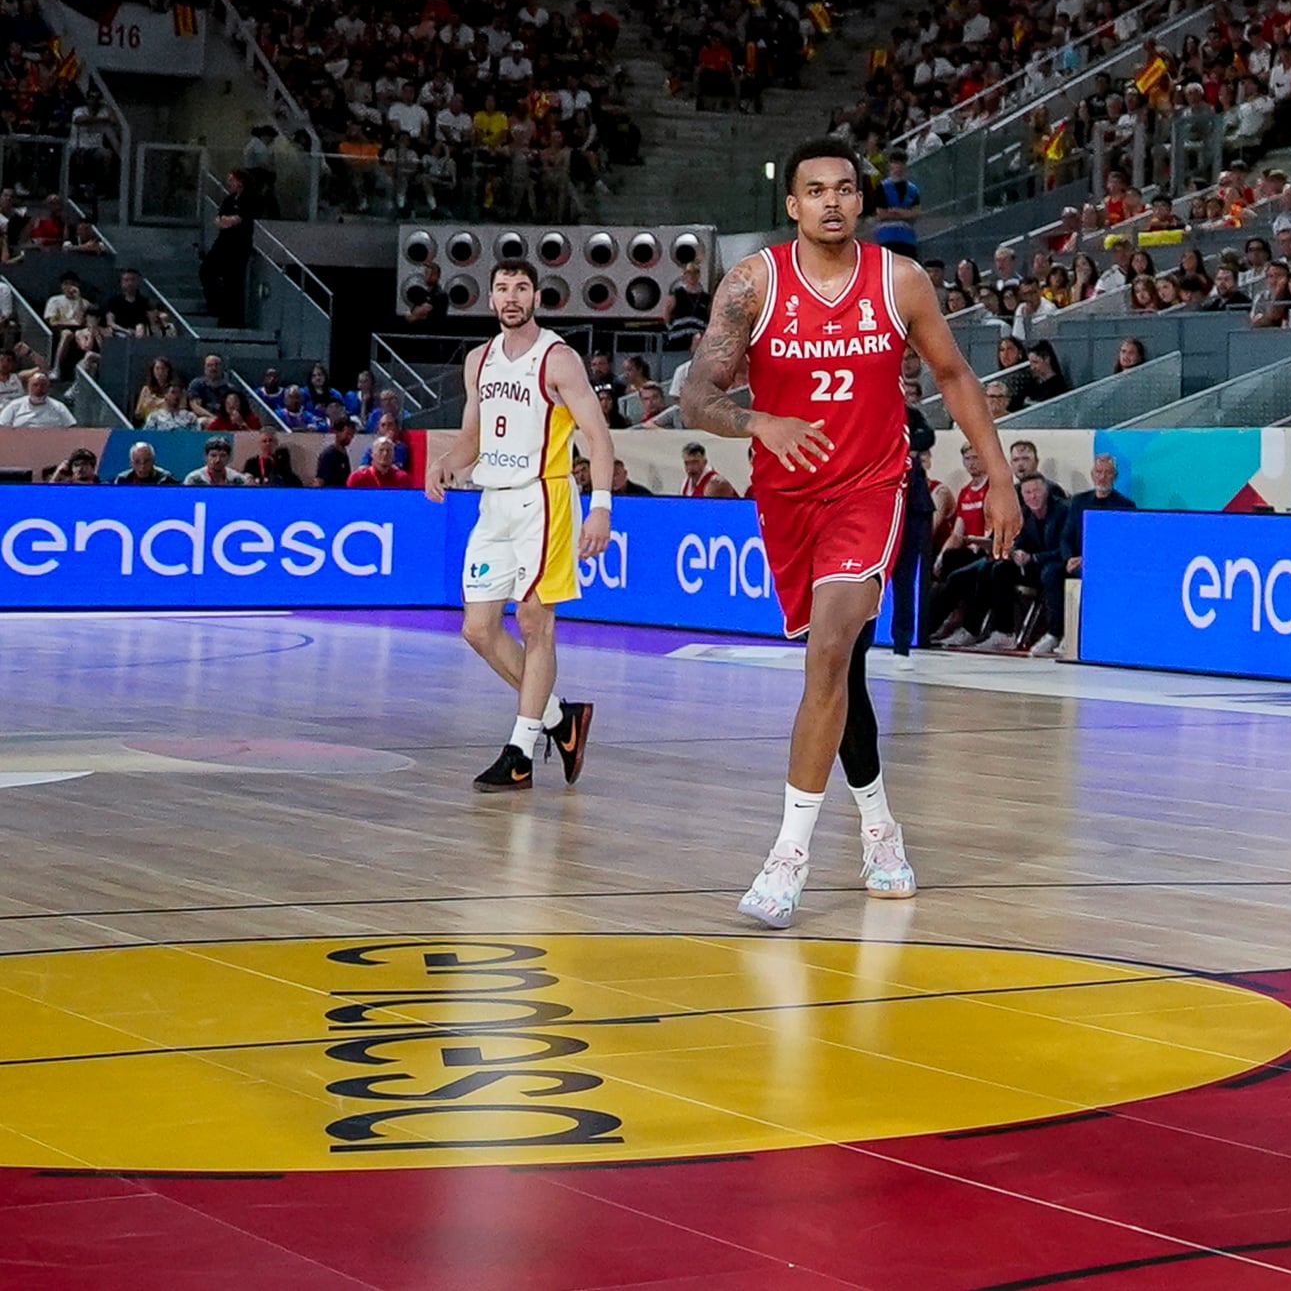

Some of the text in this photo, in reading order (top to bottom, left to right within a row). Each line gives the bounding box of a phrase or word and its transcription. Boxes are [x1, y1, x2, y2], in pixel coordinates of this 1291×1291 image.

[98, 25, 141, 49] B16
[770, 332, 892, 359] DANMARK
[810, 369, 854, 402] 22
[495, 415, 507, 438] 8
[480, 449, 530, 469] ndesa
[2, 502, 394, 576] endesa
[325, 942, 660, 1153] endesa
